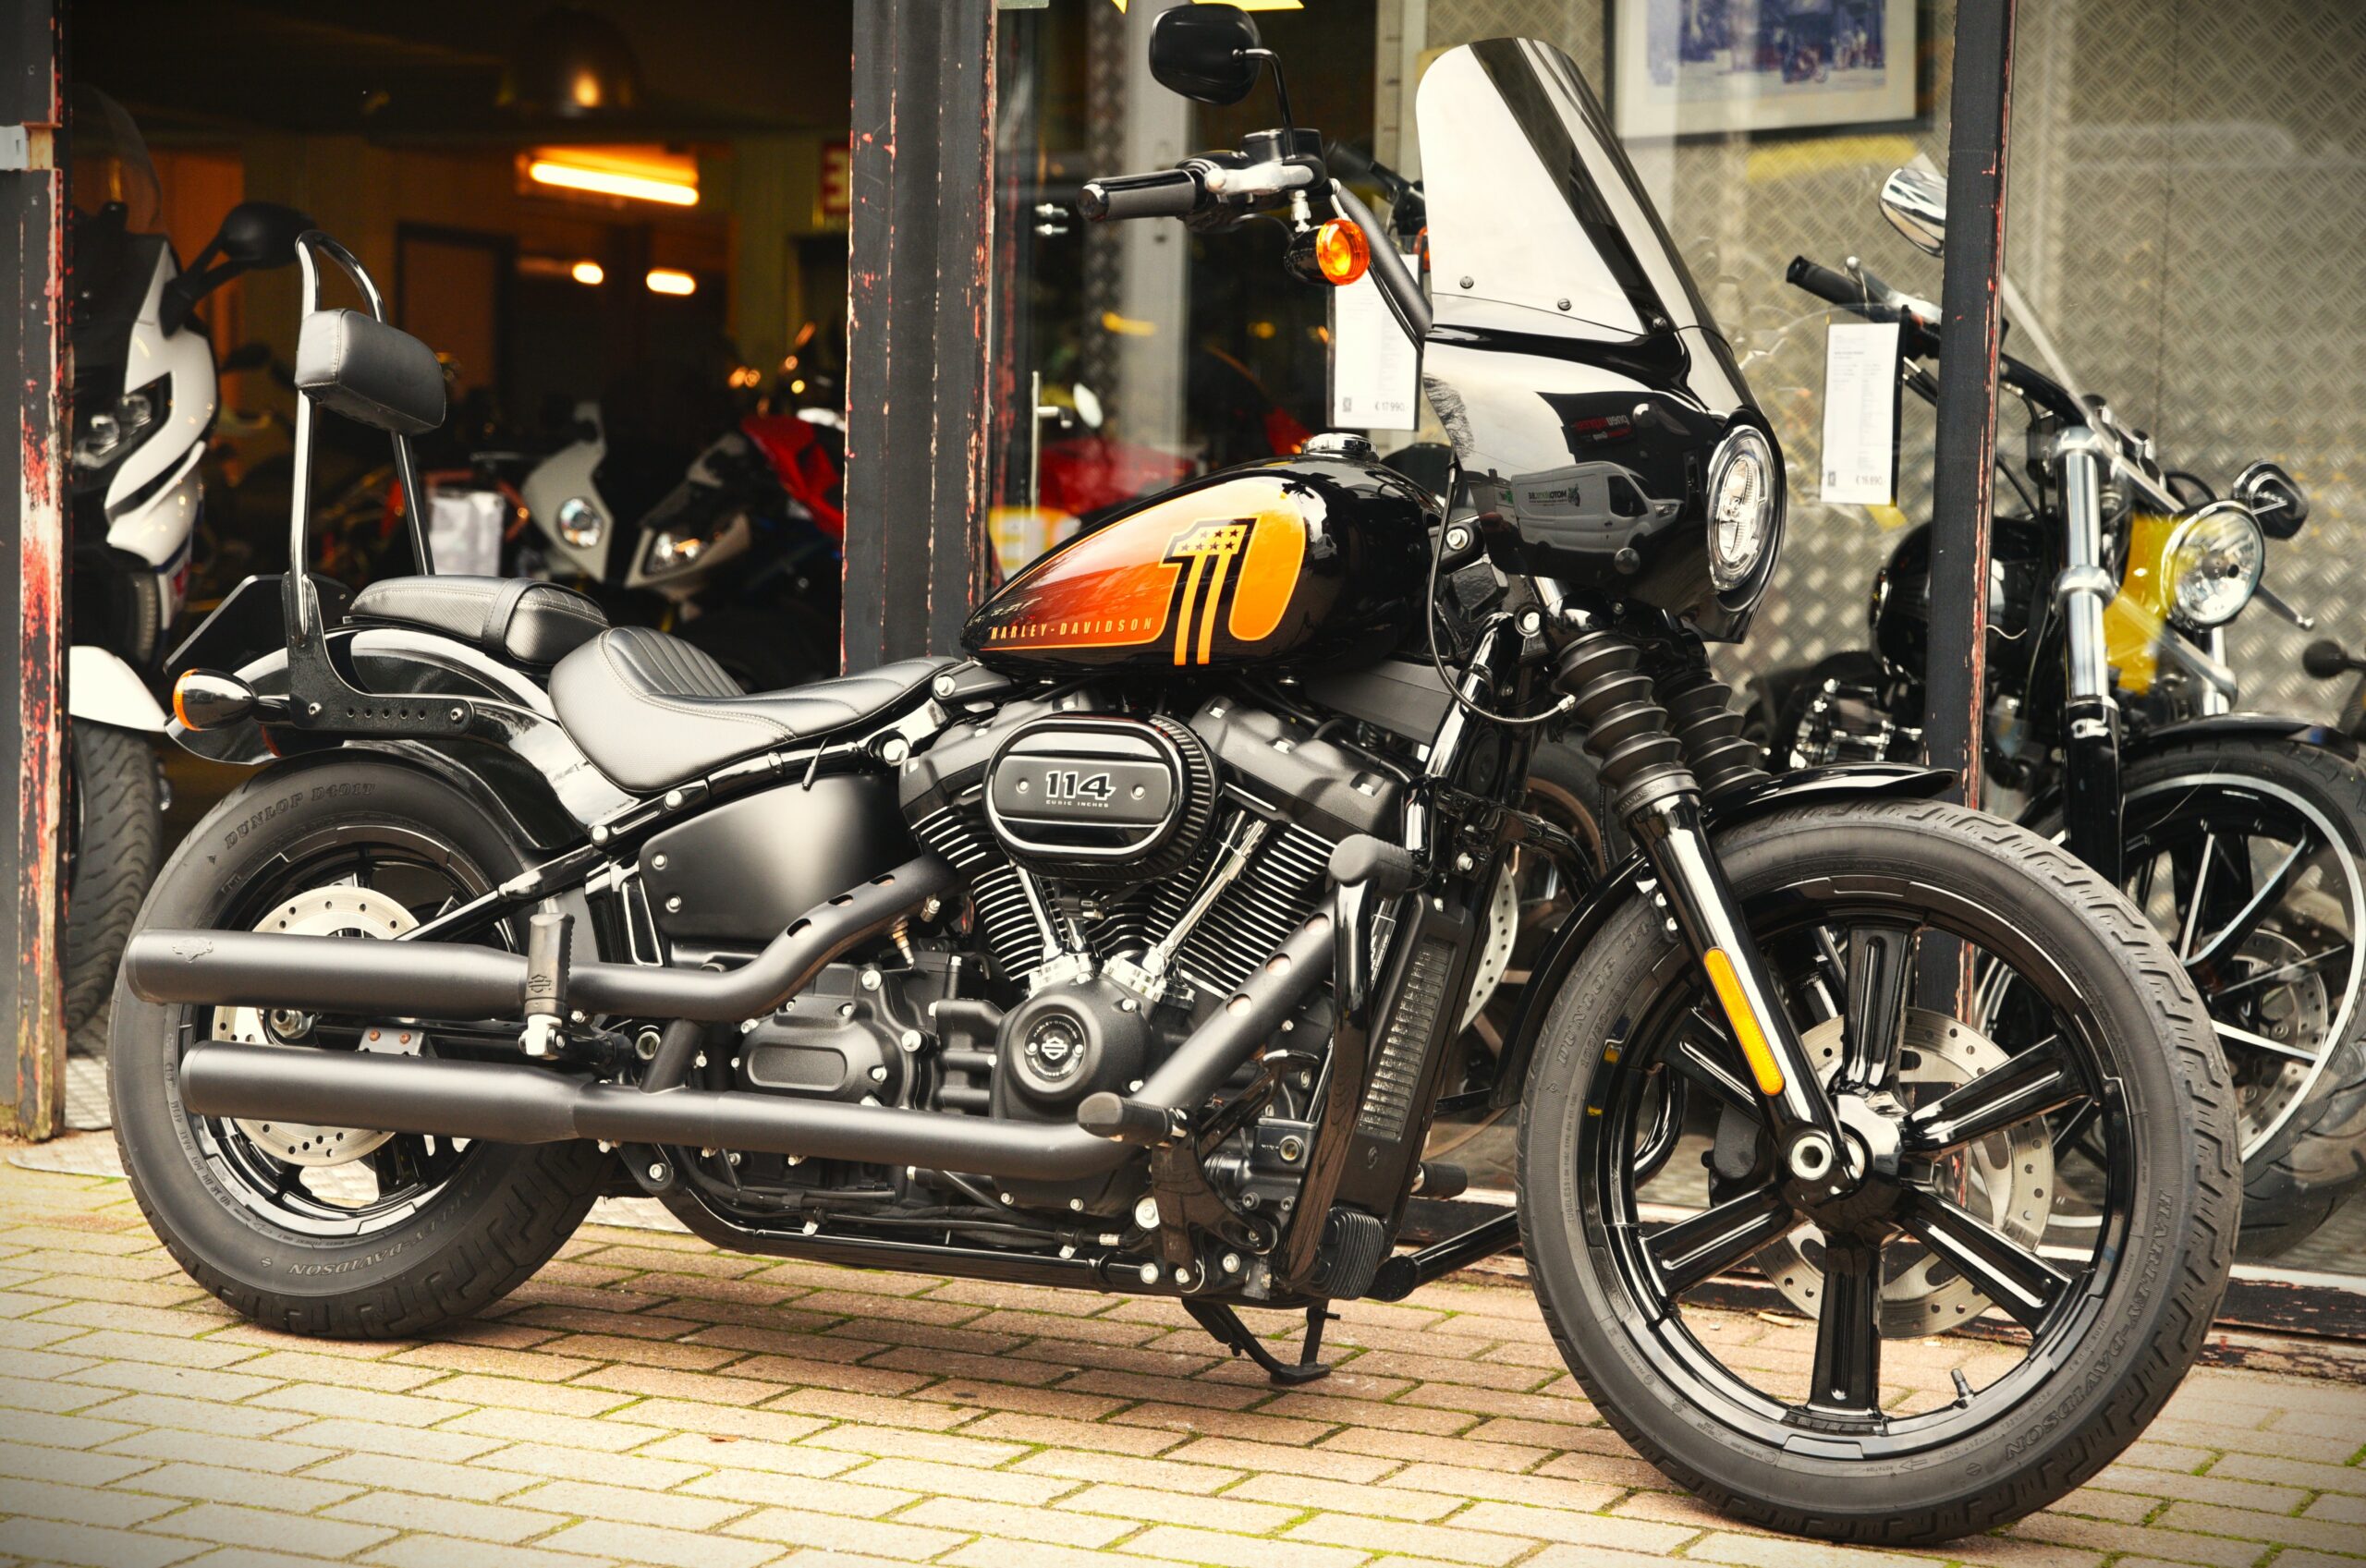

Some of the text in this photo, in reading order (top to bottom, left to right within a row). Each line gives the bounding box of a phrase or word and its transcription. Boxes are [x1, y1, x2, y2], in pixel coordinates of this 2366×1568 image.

[991, 617, 1153, 639] HARLEY-DAVIDSON
[225, 792, 304, 850] DUNLOP
[311, 783, 375, 801] D401T
[1045, 770, 1116, 801] 114
[1556, 956, 1618, 1068] DUNLOP
[2004, 1189, 2173, 1462] HARLEY-DAVIDSON
